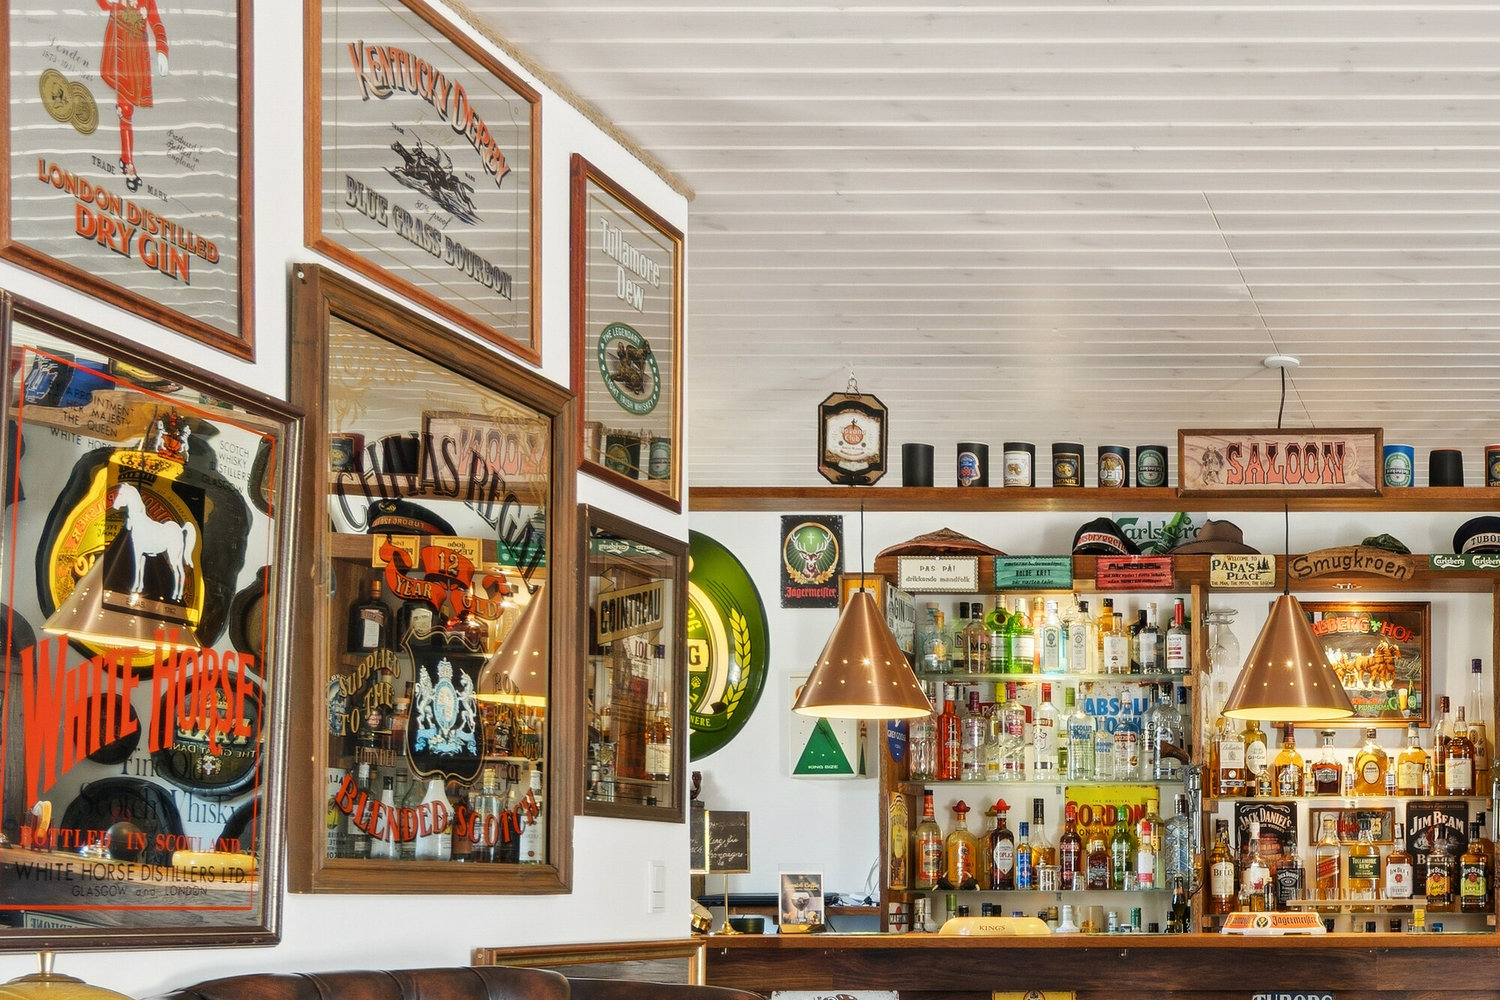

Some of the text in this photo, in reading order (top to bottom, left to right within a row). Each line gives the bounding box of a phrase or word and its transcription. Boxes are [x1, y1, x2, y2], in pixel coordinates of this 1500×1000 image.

[348, 39, 512, 188] KENTUCKY DERBY
[91, 155, 116, 175] TRADE
[147, 185, 168, 203] MARK
[37, 157, 219, 263] LONDON DISTILLED
[75, 200, 191, 285] DRY GIN
[345, 174, 512, 300] BLUE GRASS BOURBON
[600, 217, 661, 288] Tullamore
[616, 264, 646, 312] Dew
[612, 326, 642, 349] LEGENDARY
[50, 427, 82, 446] WHITE
[62, 411, 118, 439] THE QUEEN
[218, 452, 248, 470] WHISKY
[220, 440, 250, 458] SCOTCH
[1225, 441, 1347, 486] SALOON
[336, 430, 546, 595] CHIVAS REGAL
[437, 551, 459, 575] 12
[1212, 558, 1256, 573] PAPA'S
[1292, 552, 1407, 580] Smugkroen
[1433, 554, 1466, 569] Carlsberg
[1226, 571, 1262, 581] PLACE
[396, 573, 499, 619] YEAR OLD
[785, 586, 837, 598] Jägermeister
[601, 587, 661, 639] COINTREAU
[1380, 620, 1416, 643] HOF
[338, 648, 401, 698] SUPPLIED
[20, 633, 140, 806] WHITE
[148, 627, 256, 757] HORSE
[340, 681, 395, 738] TO THE
[335, 772, 541, 847] BLENDED SCOTCH
[1240, 811, 1259, 830] JACK
[1409, 810, 1464, 837] JIM BEAM
[19, 825, 241, 853] BOTTLED IN SCOTLAND
[15, 860, 248, 885] WHITE HORSE DISTILLERS LTD.
[72, 885, 208, 897] GLASGOW and LONDON
